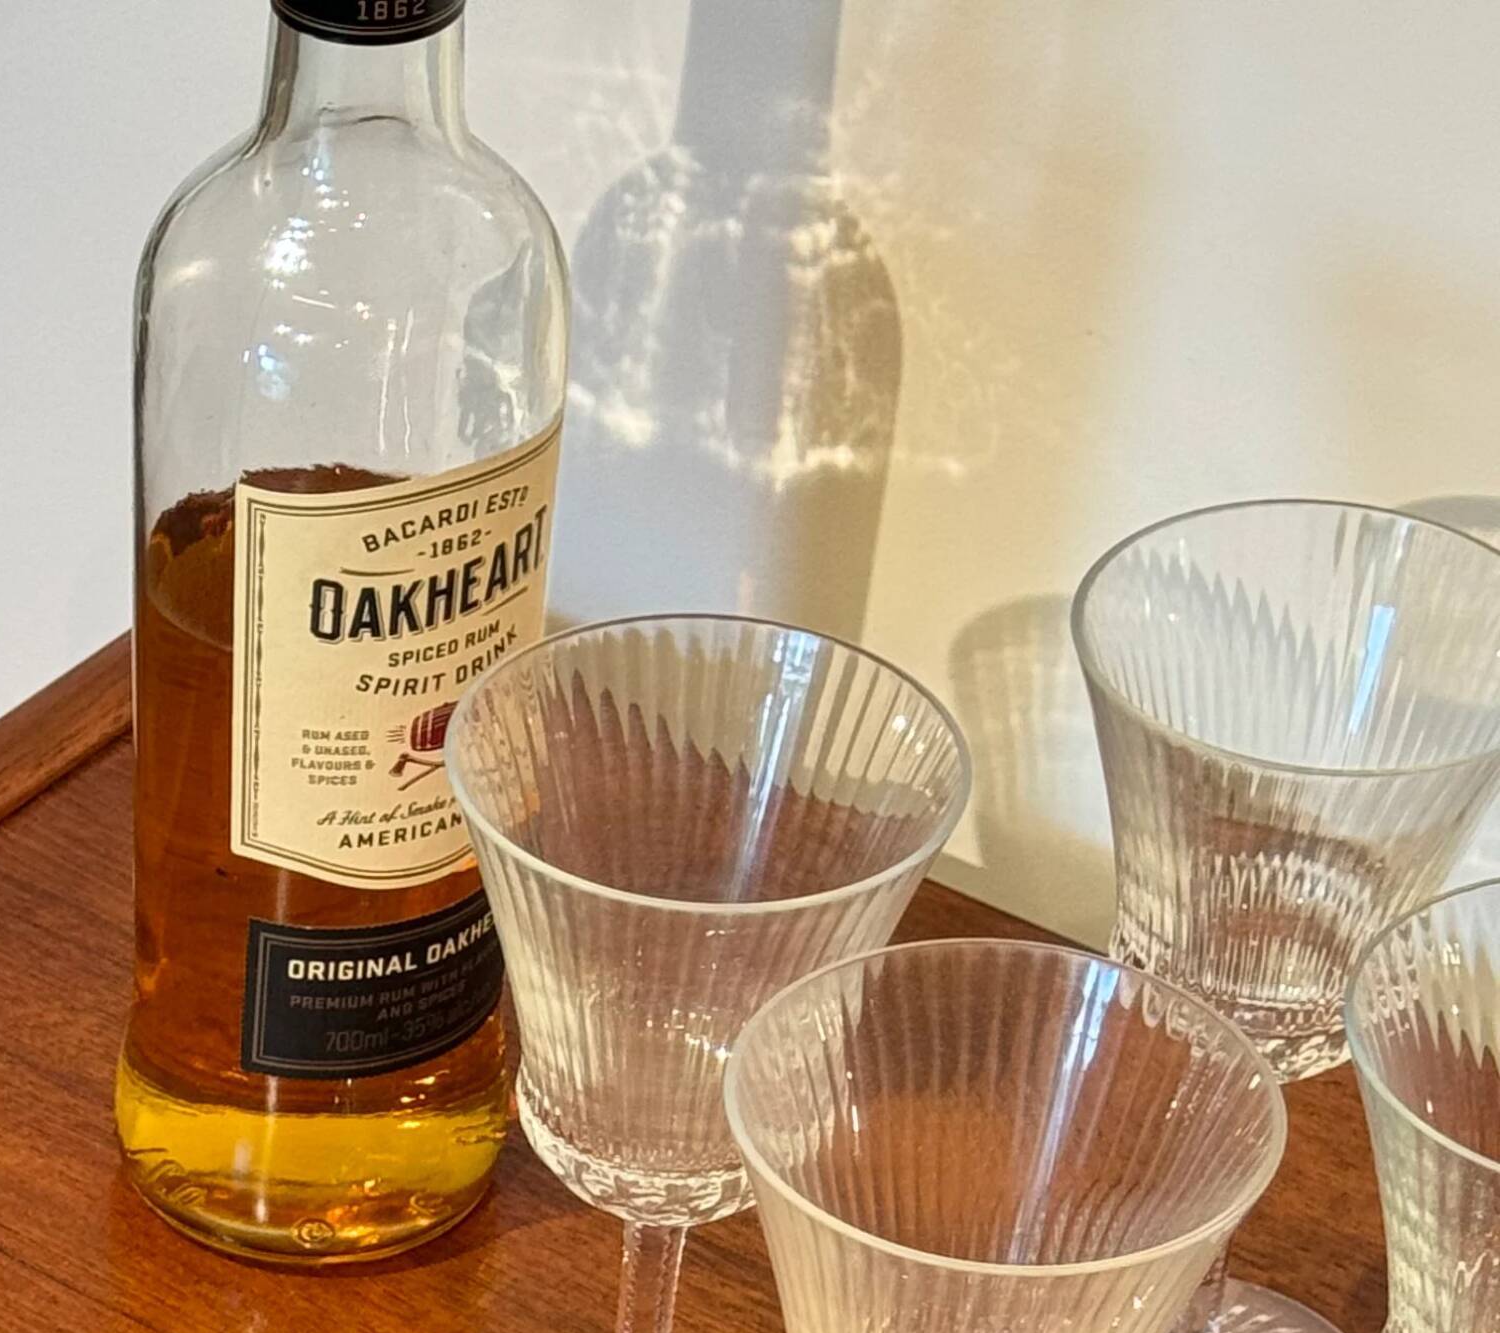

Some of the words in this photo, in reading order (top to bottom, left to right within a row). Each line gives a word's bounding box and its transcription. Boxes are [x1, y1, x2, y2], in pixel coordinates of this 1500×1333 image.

[357, 0, 426, 20] 1862
[362, 498, 478, 553] BACARDI
[309, 504, 547, 643] OAKHEART
[356, 673, 446, 697] SPIRIT
[455, 624, 518, 685] DRINK
[388, 639, 459, 668] SPICED
[465, 620, 501, 647] RUM
[302, 729, 331, 741] RUM
[291, 758, 361, 771] FLAVOURS
[364, 760, 376, 770] &
[308, 774, 357, 786] SPICES
[317, 810, 337, 826] A
[338, 810, 377, 826] Hint
[378, 803, 402, 823] of
[400, 796, 447, 819] Smoke
[339, 812, 462, 849] AMERICAN
[287, 951, 418, 981] ORIGINAL
[289, 994, 373, 1010] PREMIUM
[379, 987, 416, 1005] RUM
[421, 972, 458, 995] WITH
[376, 1004, 414, 1022] AND
[418, 979, 467, 1011] SPICES
